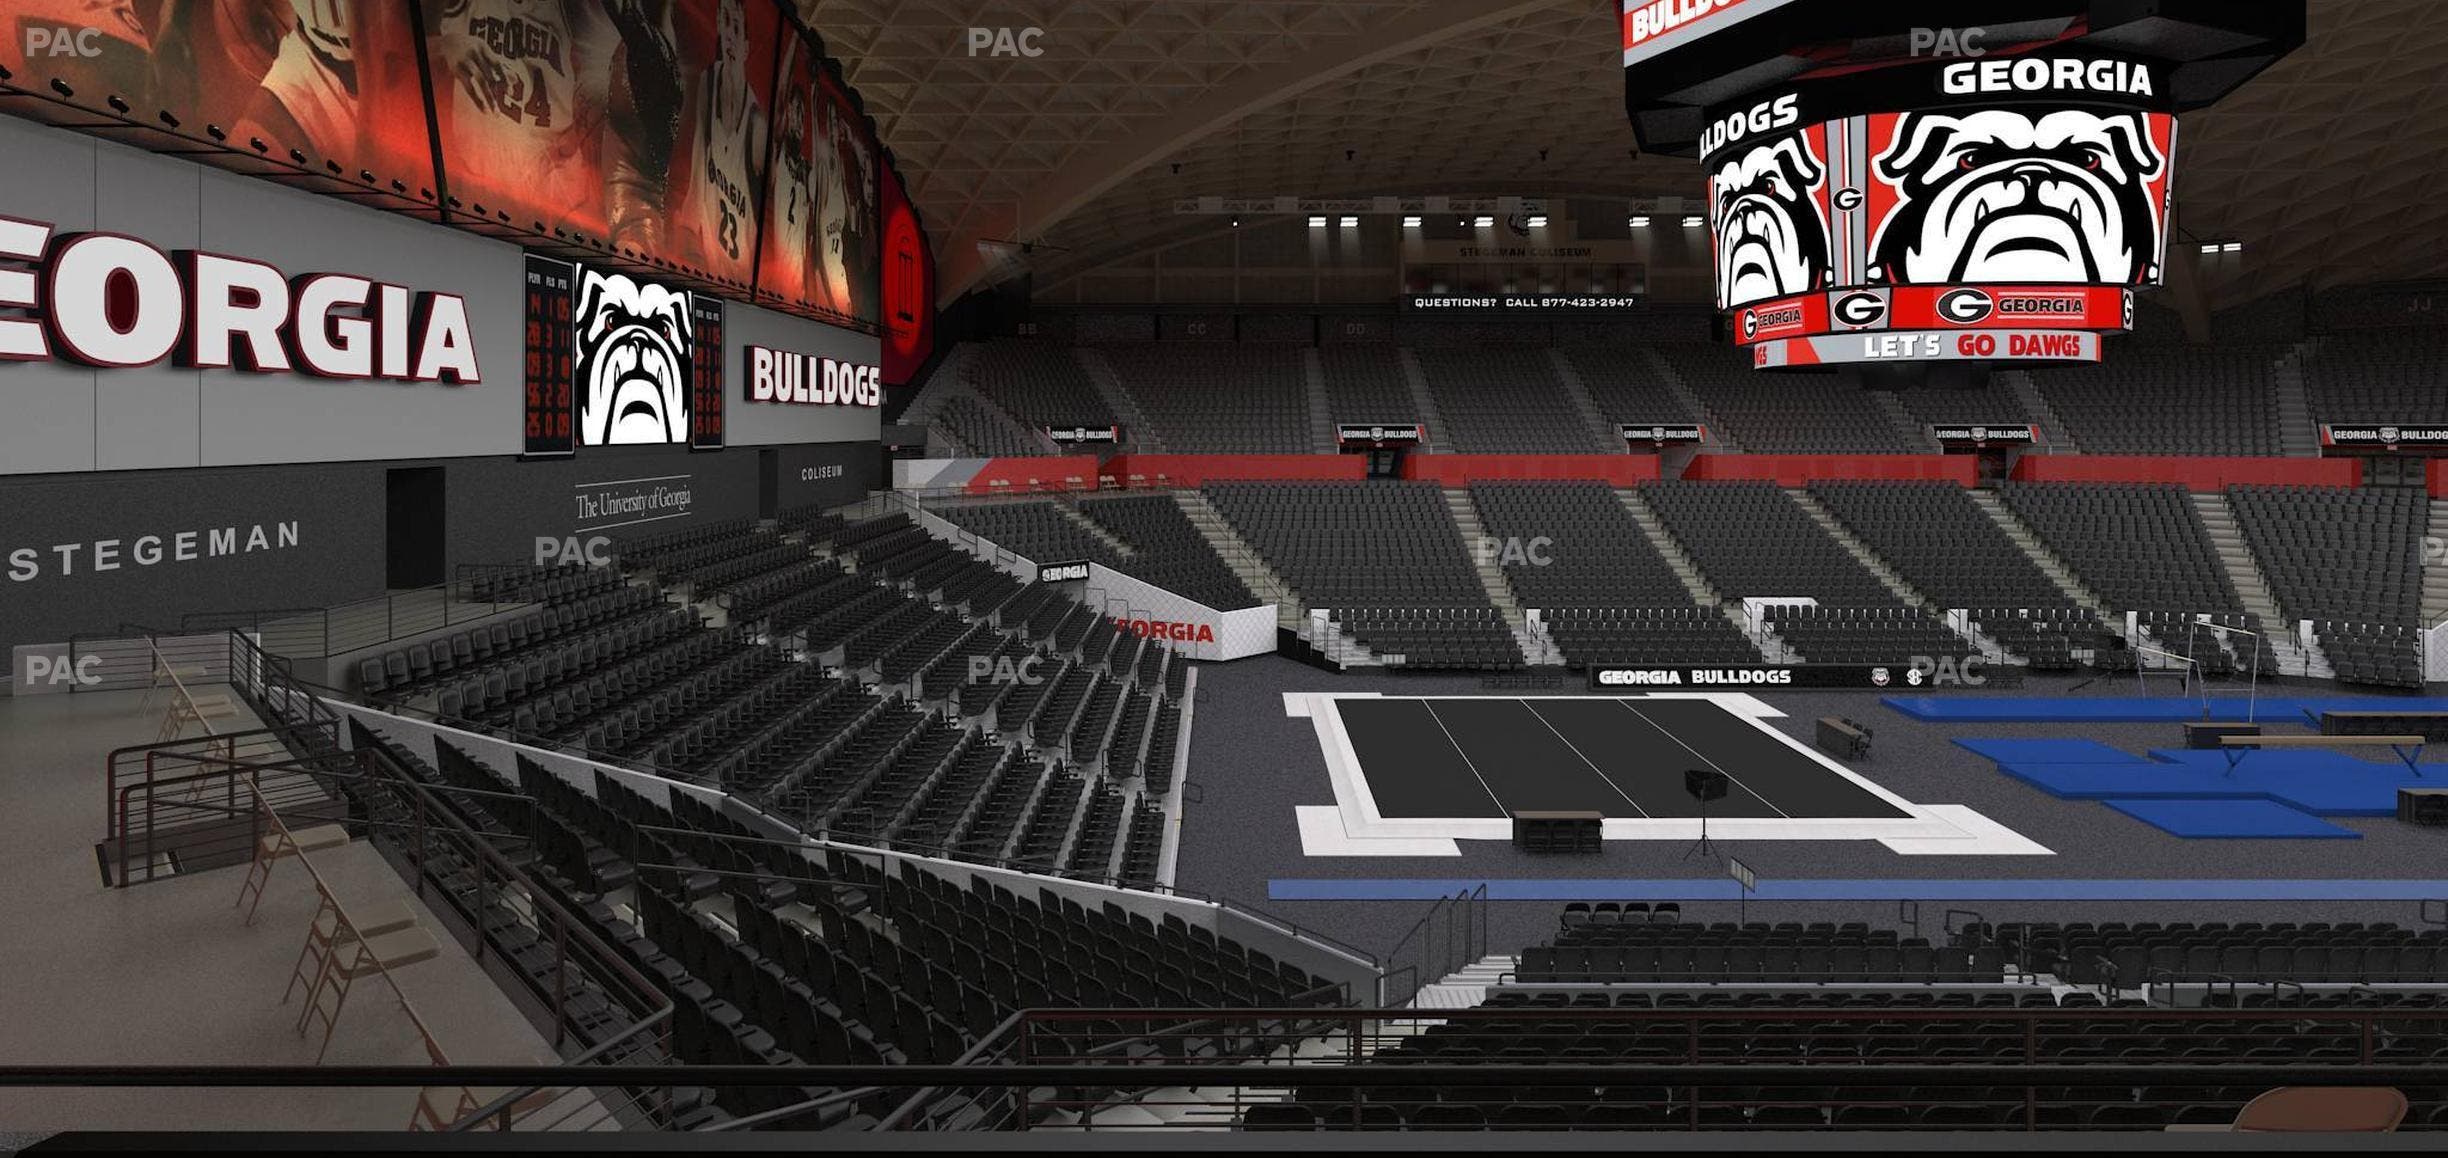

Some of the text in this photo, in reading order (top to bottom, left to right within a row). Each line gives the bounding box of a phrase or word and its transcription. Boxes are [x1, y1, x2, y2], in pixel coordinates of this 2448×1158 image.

[1633, 0, 1746, 43] BULL
[1944, 58, 2152, 96] GEORGIA
[718, 199, 739, 260] 23
[1415, 298, 1634, 307] QUESTIONS? CALL 877-423-2947
[1832, 291, 1887, 327] G
[1936, 288, 2084, 324] G GEORGIA
[1758, 310, 1801, 327] GEORGIA
[1864, 334, 2080, 358] LET'S GO DAWGS
[751, 345, 881, 407] BULLDOGS
[1343, 430, 1371, 438] GEORGIA
[1988, 430, 2029, 438] BULLDOGS
[2334, 430, 2377, 439] GEORGIA
[802, 465, 842, 481] COLISEUM
[576, 485, 691, 518] The University of Georgia
[8, 521, 298, 582] STEGEMAN
[1042, 565, 1088, 581] GEORGIA
[1599, 670, 1791, 684] GEORGIA BULLDOGS
